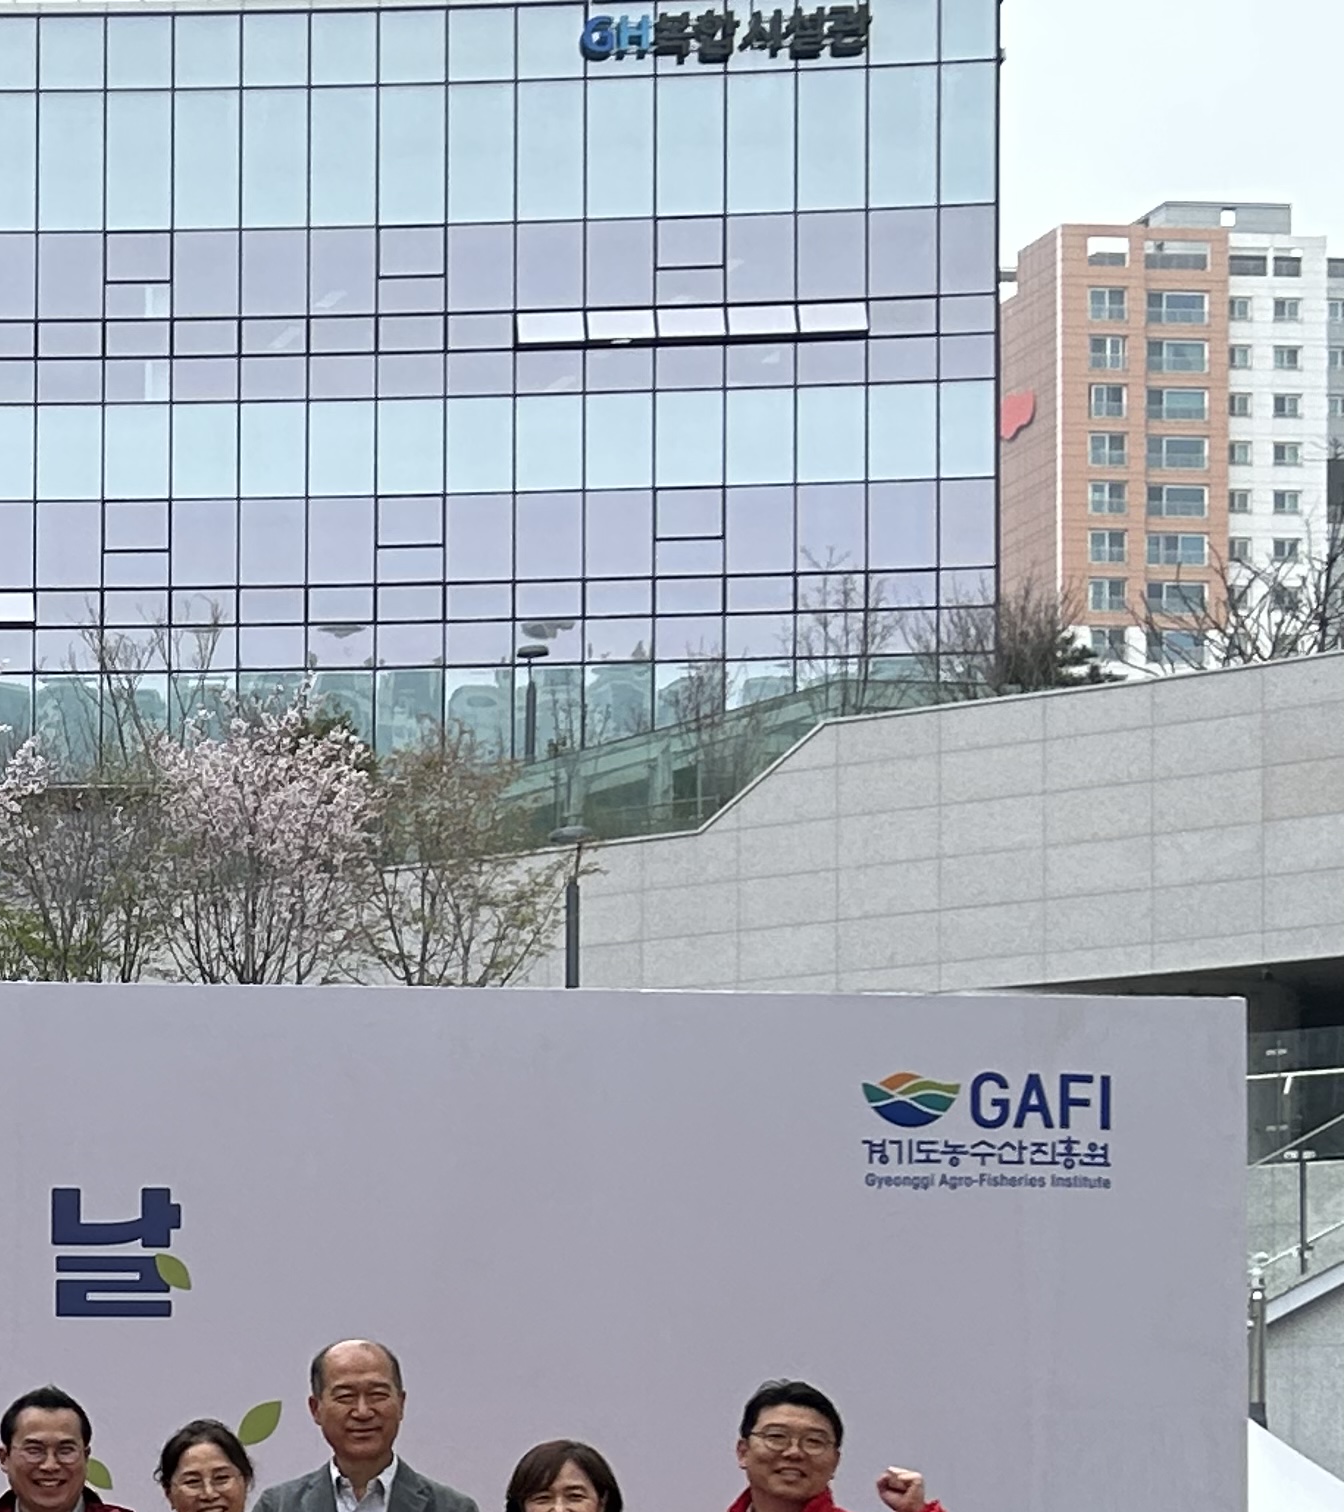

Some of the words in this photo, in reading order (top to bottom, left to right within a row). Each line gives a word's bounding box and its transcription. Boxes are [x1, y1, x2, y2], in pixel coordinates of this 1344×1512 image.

[969, 1071, 1111, 1130] GAFI
[862, 1136, 1111, 1169] 경기도농수산진흥원
[864, 1173, 935, 1190] Gyeonggi
[939, 1173, 1046, 1190] Agro-Fisheries
[1050, 1174, 1111, 1189] Institute
[51, 1186, 186, 1318] 날
